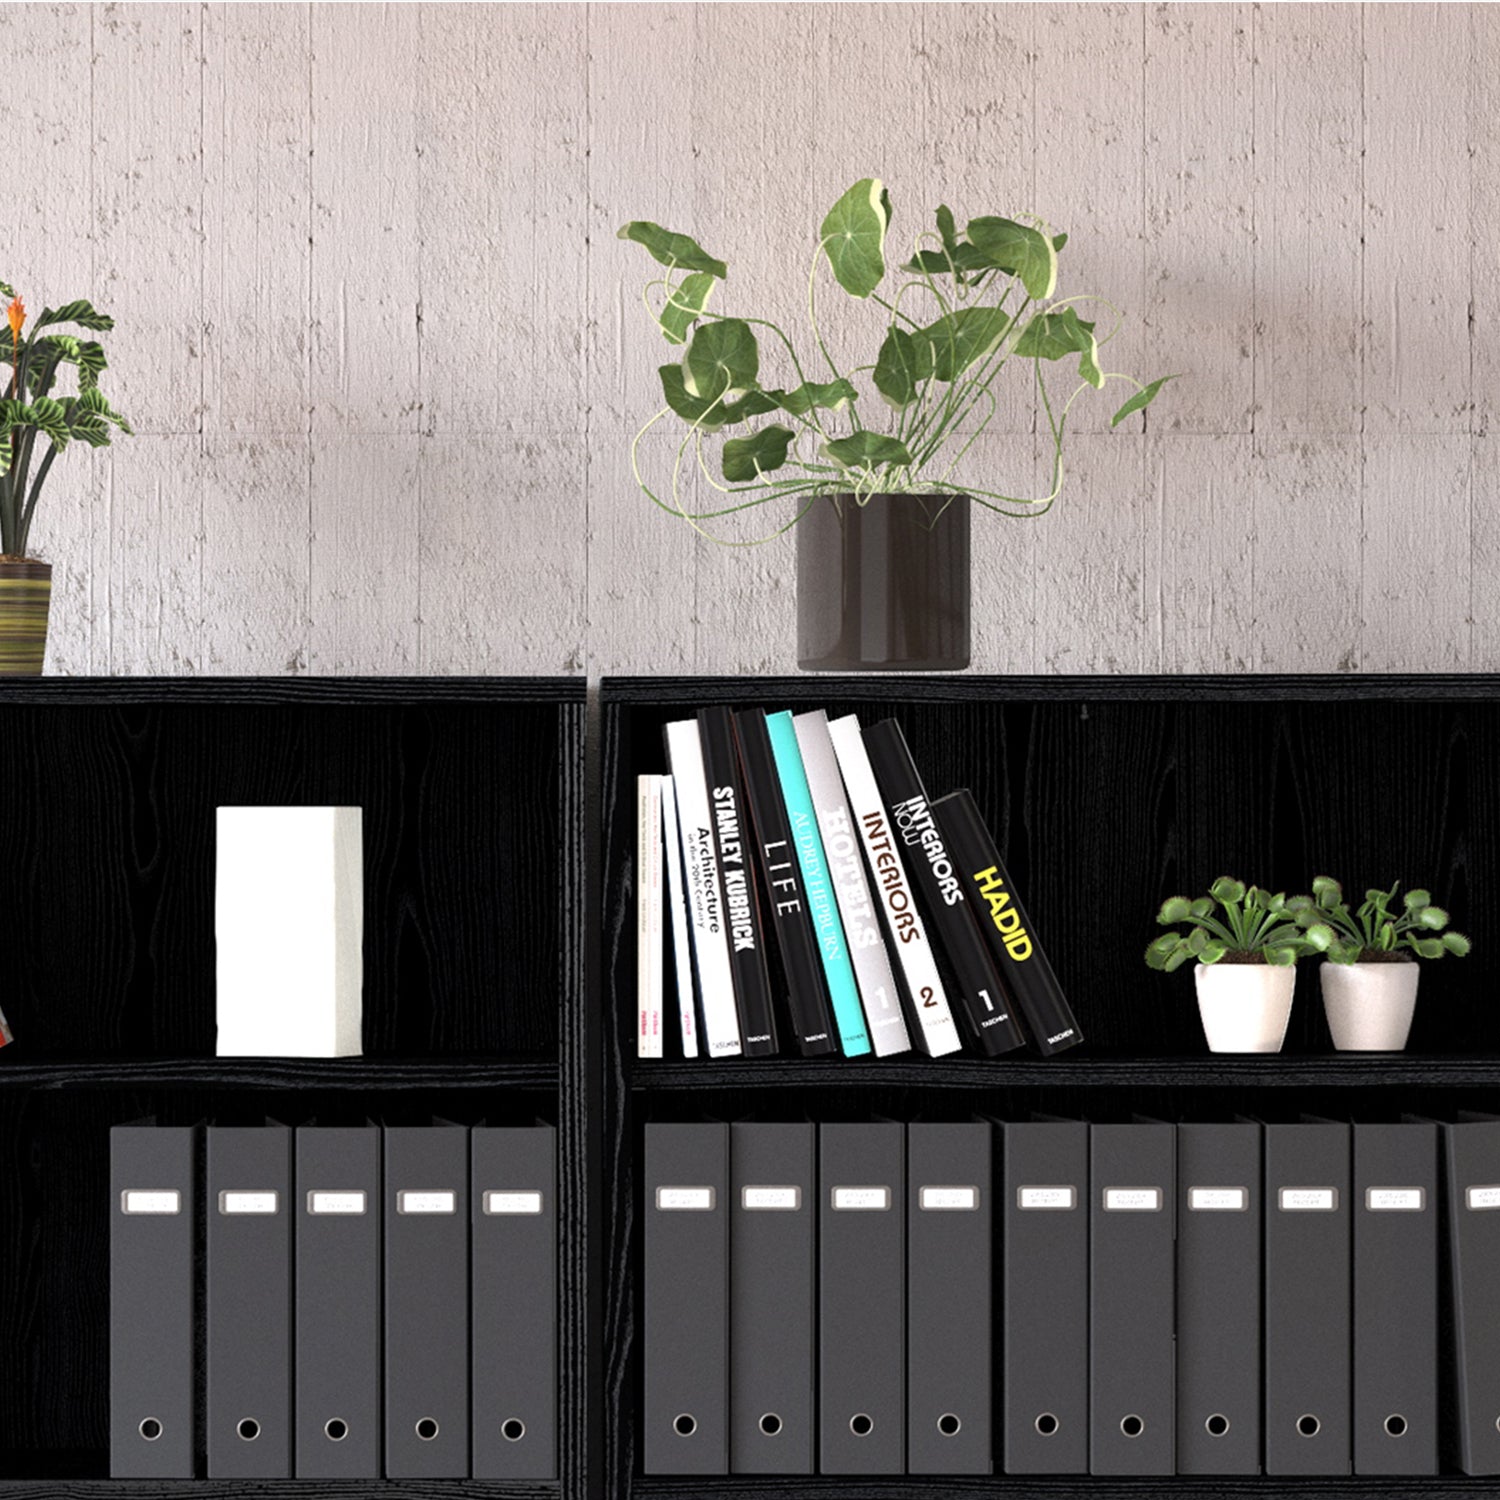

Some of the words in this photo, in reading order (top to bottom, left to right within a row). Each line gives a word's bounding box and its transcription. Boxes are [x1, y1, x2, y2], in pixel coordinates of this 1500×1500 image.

[713, 786, 743, 864] STANLEY
[892, 802, 921, 846] NOW
[907, 795, 964, 906] INTERIORS
[697, 827, 720, 934] Architecture
[724, 869, 755, 953] KUBRICK
[764, 840, 801, 917] LIFE
[793, 811, 823, 878] AUDREY
[809, 879, 842, 960] HEPBURN
[822, 806, 878, 949] HOTELS
[862, 811, 921, 944] INTERIORS
[973, 865, 1033, 962] HADID
[875, 986, 890, 1009] 1
[920, 986, 938, 1008] 2
[978, 989, 994, 1012] 1
[981, 1013, 1009, 1029] TASCHEN
[1047, 1028, 1075, 1044] TASCHEN
